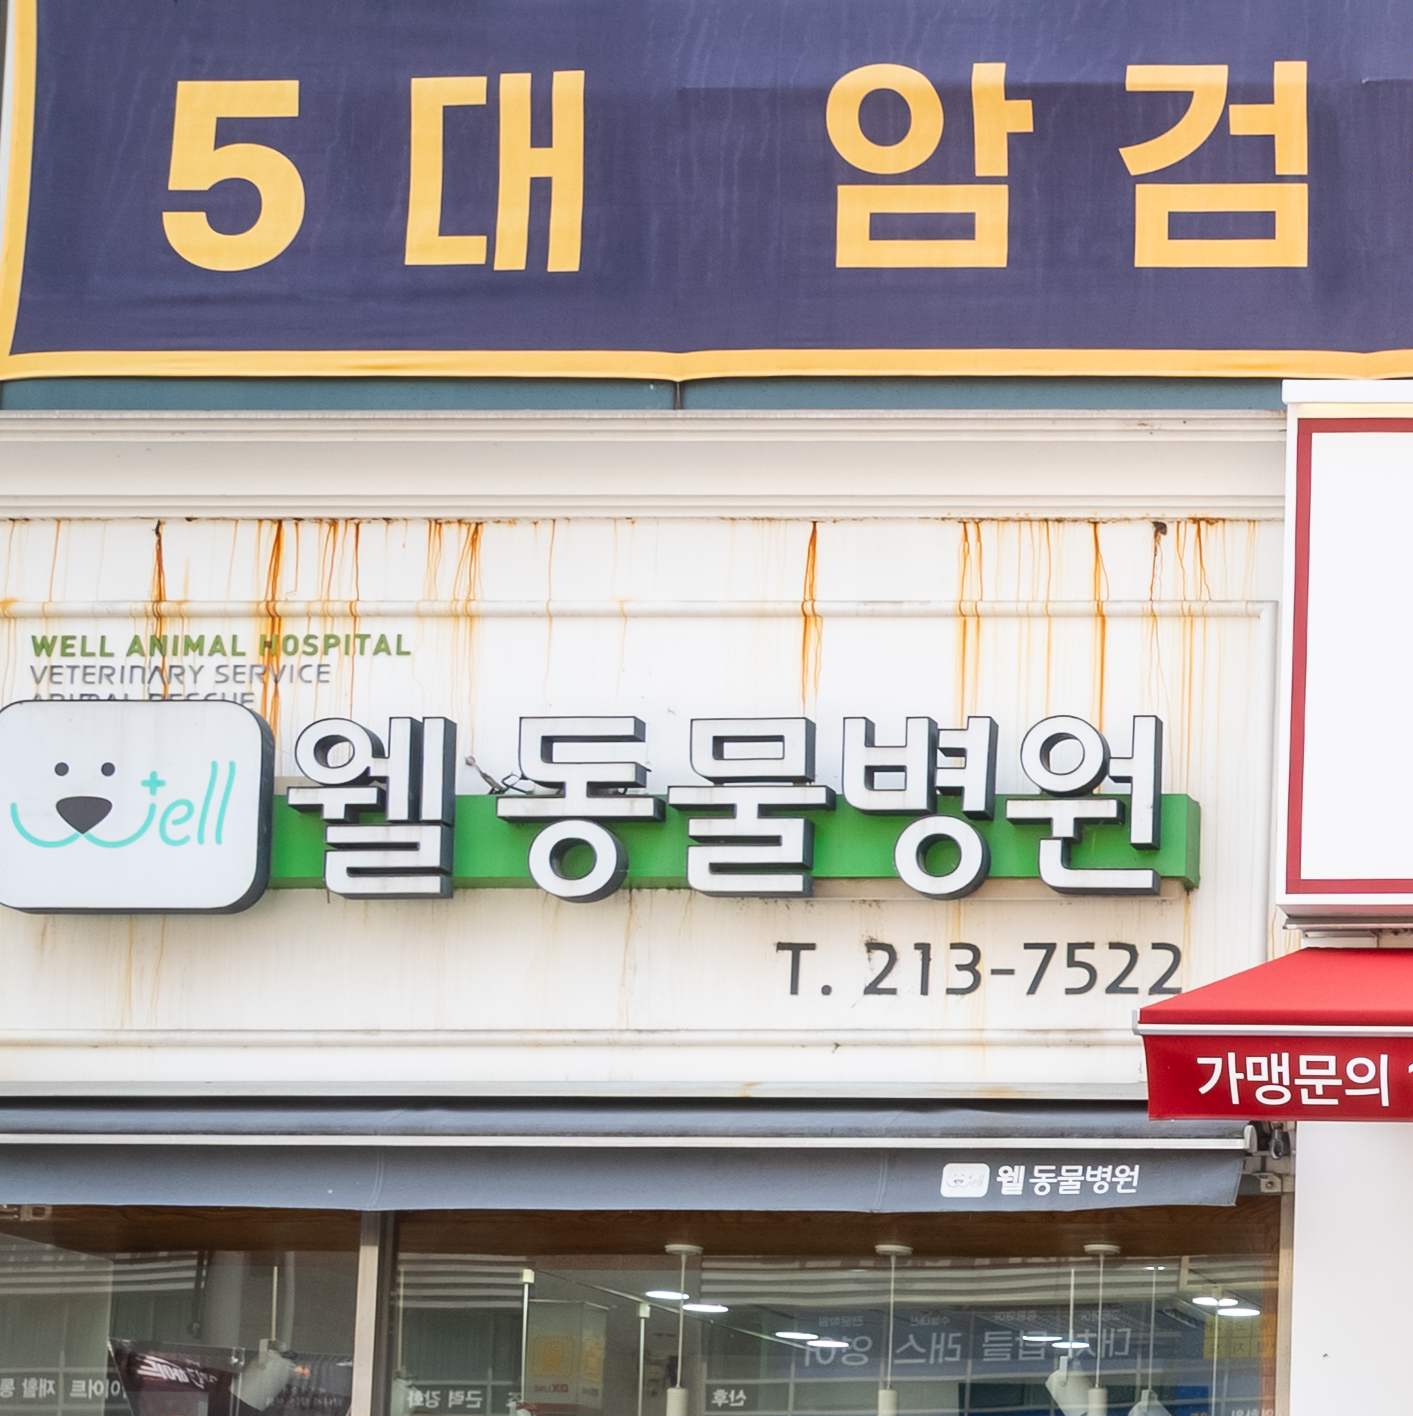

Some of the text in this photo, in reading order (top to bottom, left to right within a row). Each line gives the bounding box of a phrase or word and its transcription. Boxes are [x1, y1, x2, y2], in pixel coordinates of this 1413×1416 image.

[31, 633, 412, 657] WELL ANIMAL HOSPITAL
[30, 663, 332, 686] VETERINARY SERVICE
[287, 714, 1164, 900] 웰 동물병원
[863, 941, 1184, 997] 213-7522
[1196, 1051, 1390, 1108] 가맹문의
[996, 1162, 1142, 1196] 웰 동물병원
